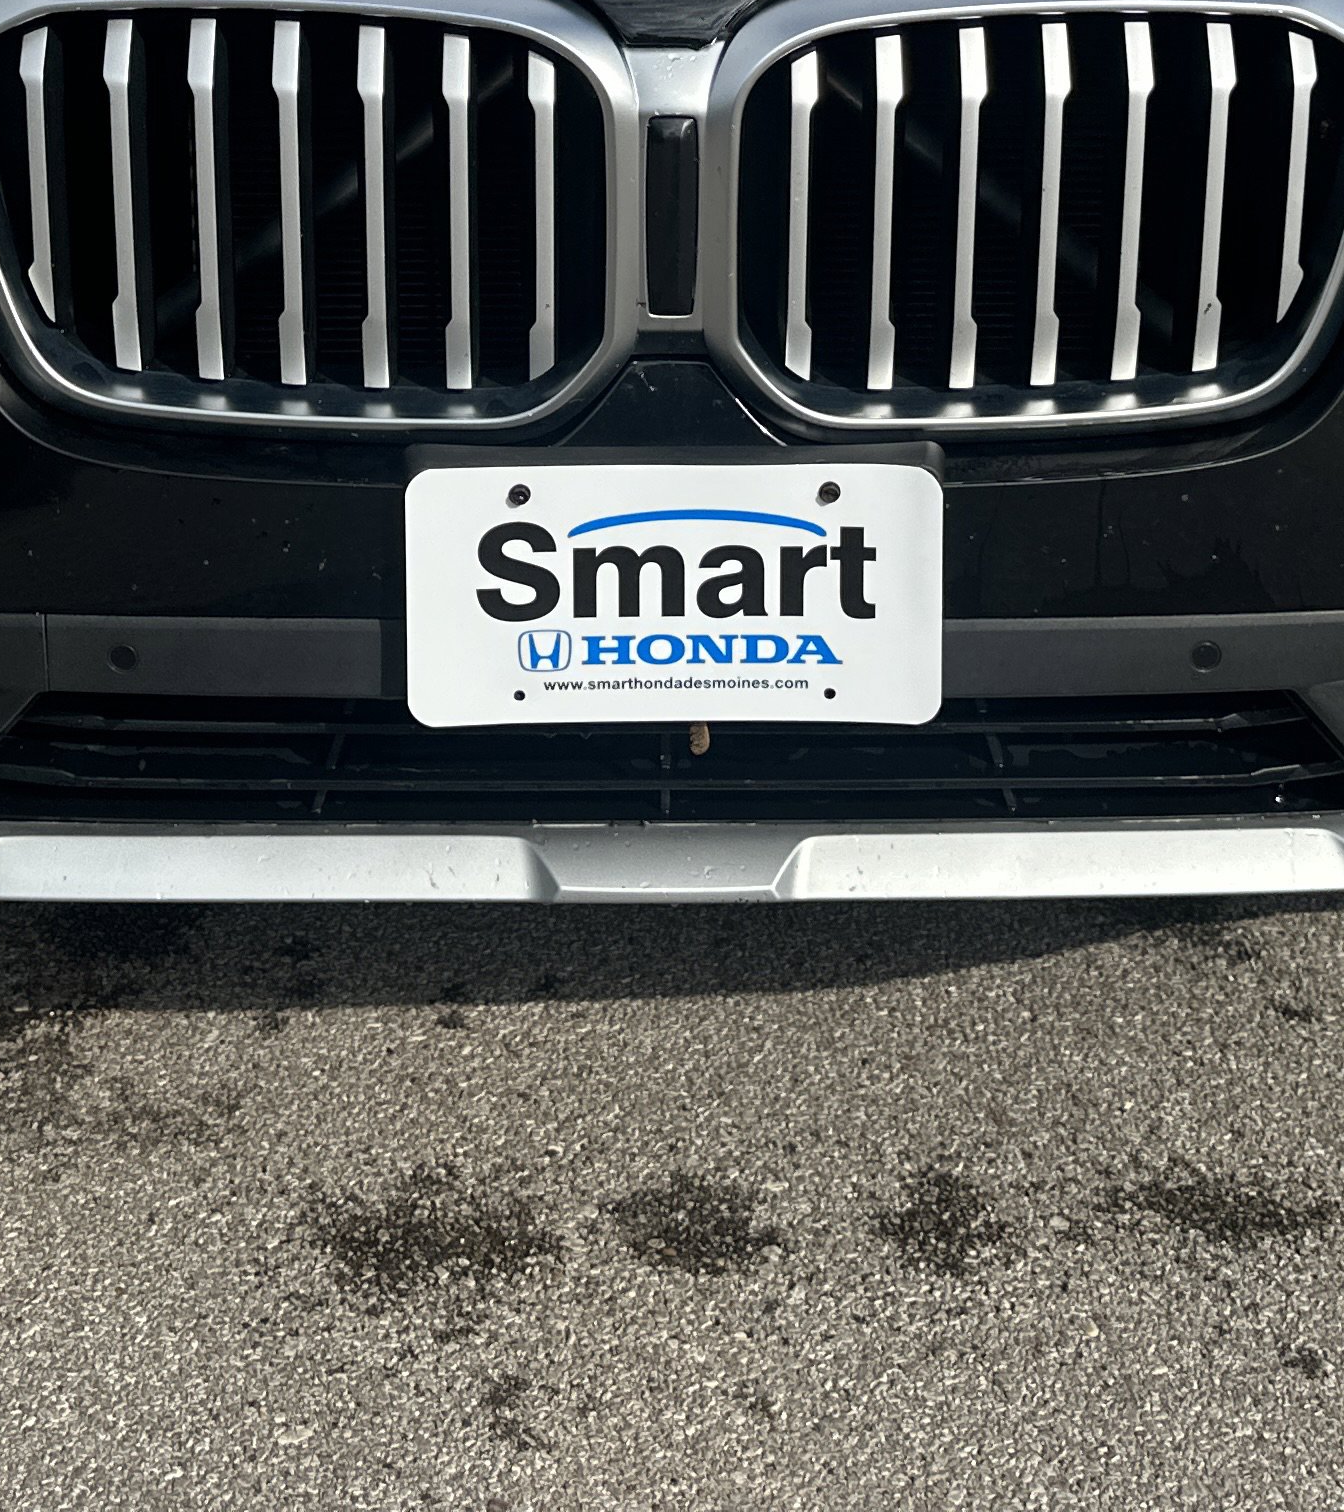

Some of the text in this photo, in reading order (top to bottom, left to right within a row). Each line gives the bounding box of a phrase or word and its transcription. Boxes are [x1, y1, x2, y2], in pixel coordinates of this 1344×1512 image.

[476, 521, 877, 622] Smart
[581, 634, 844, 665] HONDA
[543, 676, 809, 692] www.smarthondadesmoines.com
